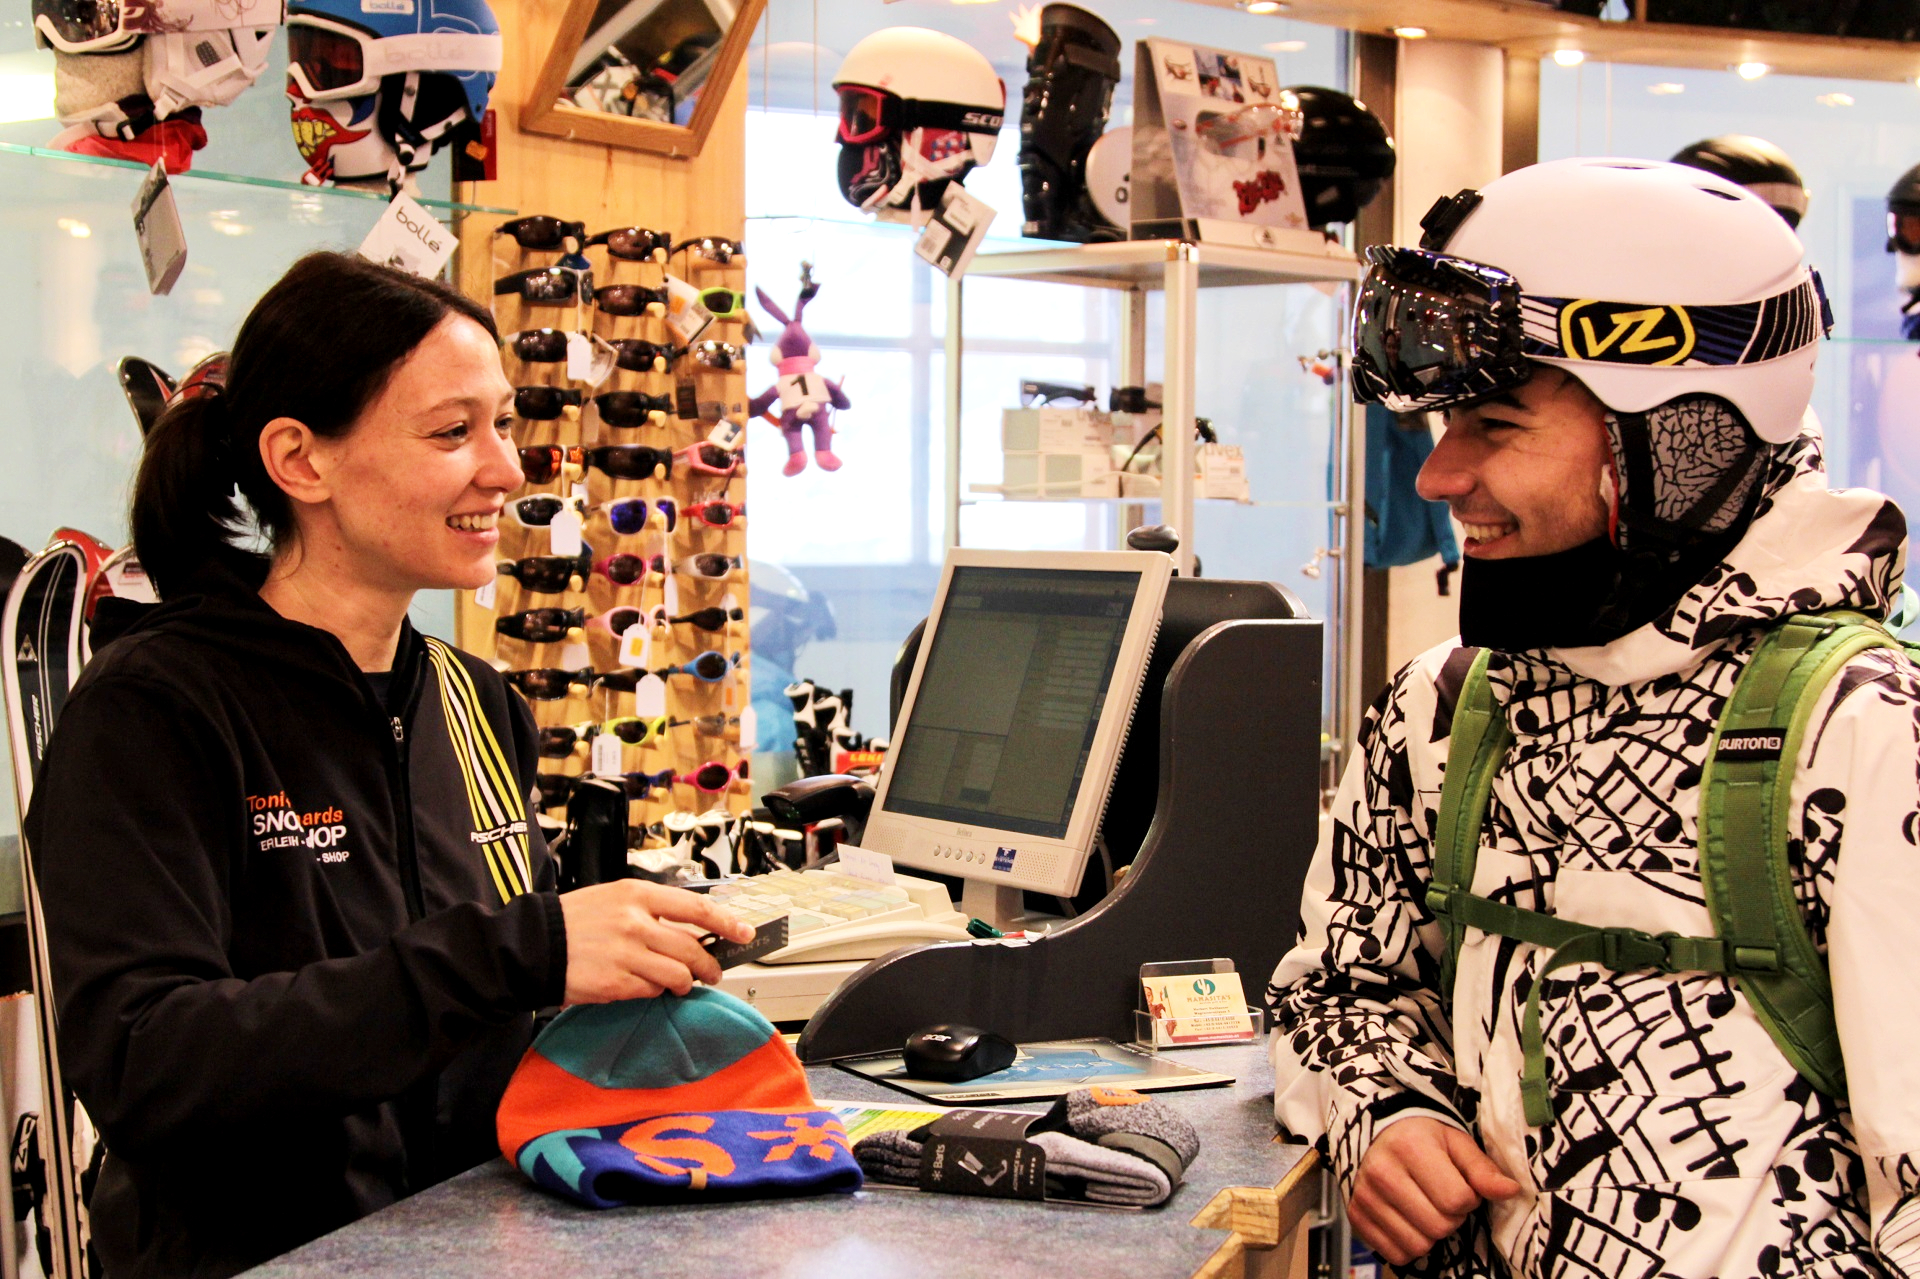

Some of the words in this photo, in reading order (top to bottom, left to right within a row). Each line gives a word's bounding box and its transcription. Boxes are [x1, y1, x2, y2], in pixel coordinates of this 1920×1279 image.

[396, 206, 444, 253] bollé
[790, 374, 809, 396] 1
[1719, 737, 1767, 750] BURTON
